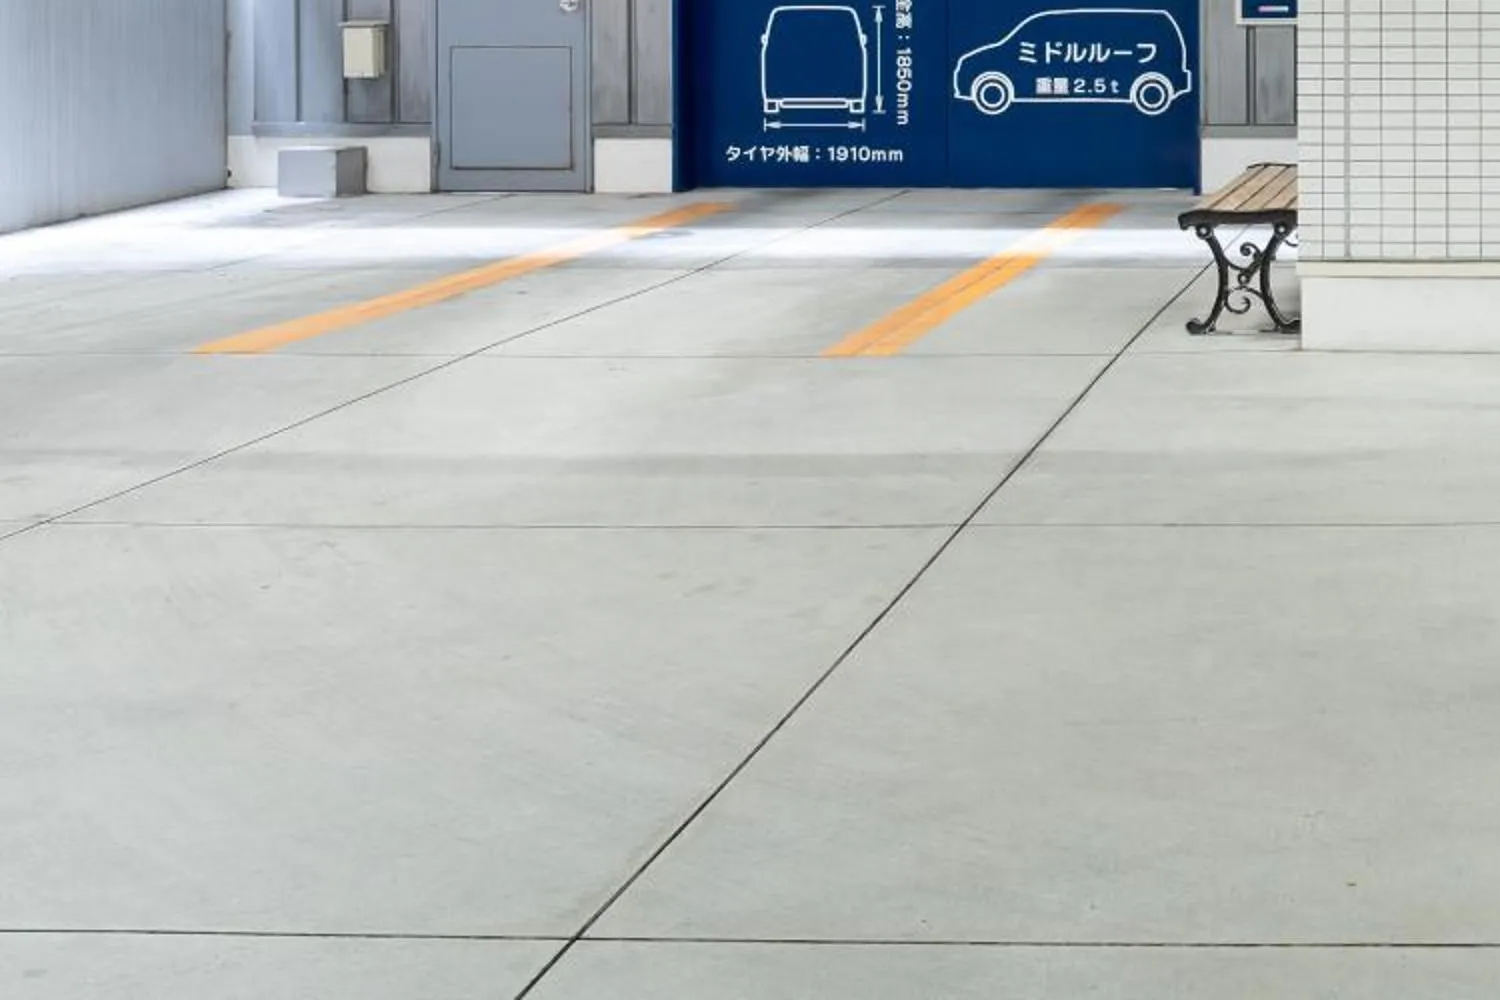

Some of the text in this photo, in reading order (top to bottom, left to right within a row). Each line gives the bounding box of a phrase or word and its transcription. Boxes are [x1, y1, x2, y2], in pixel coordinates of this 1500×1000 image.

[1018, 41, 1158, 64] ミドルルーフ
